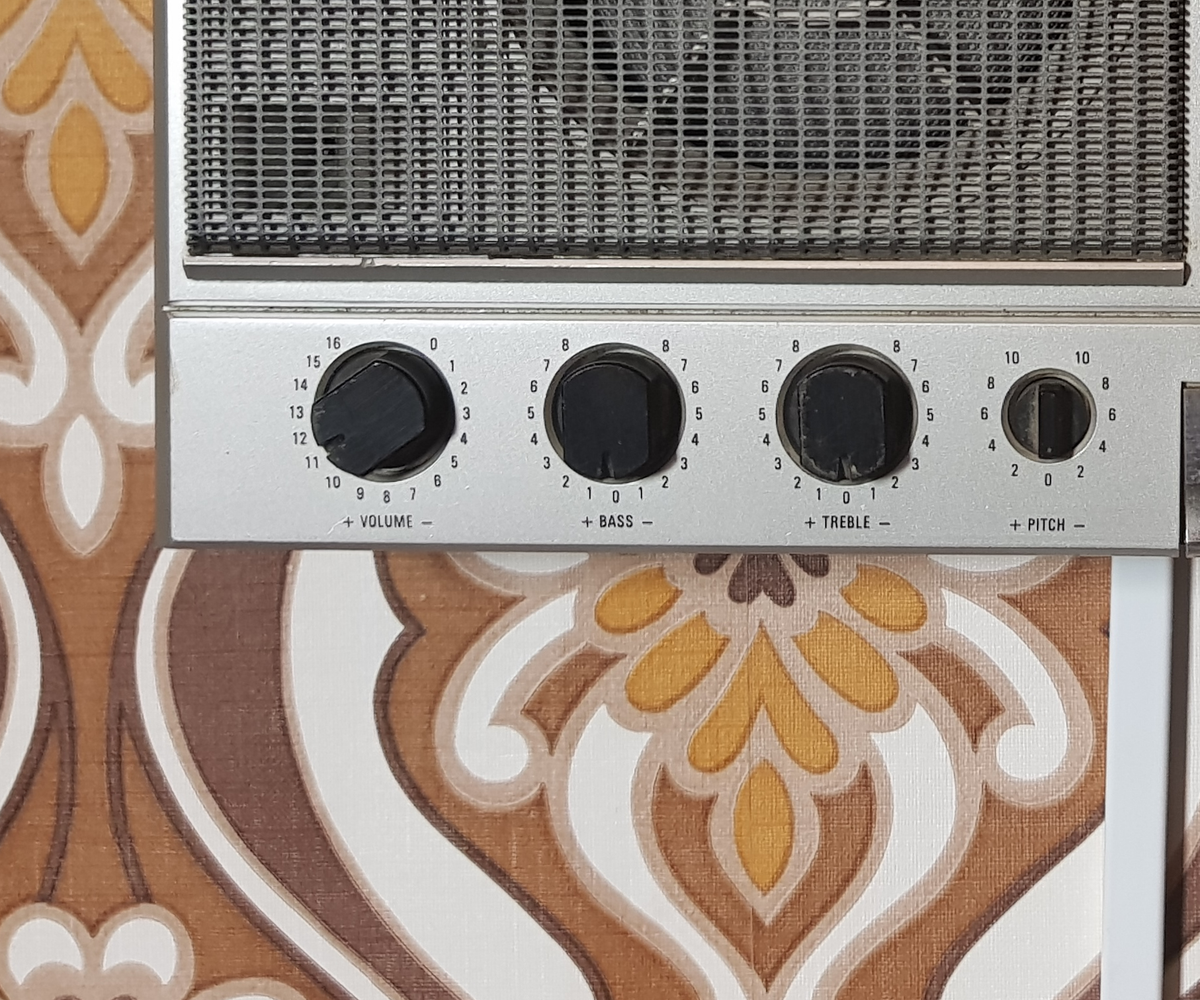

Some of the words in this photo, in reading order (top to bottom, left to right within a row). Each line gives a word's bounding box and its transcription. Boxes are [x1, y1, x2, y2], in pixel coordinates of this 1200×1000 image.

[326, 335, 341, 351] 16
[429, 337, 438, 352] 0
[561, 337, 570, 352] 8
[661, 338, 670, 353] 8
[791, 339, 800, 354] 8
[892, 339, 901, 354] 8
[306, 354, 321, 369] 15
[542, 358, 551, 372] 7
[680, 358, 688, 372] 7
[1004, 350, 1020, 365] 10
[1075, 350, 1090, 365] 10
[449, 359, 456, 373] 1
[775, 358, 783, 373] 7
[910, 358, 918, 373] 7
[293, 377, 309, 392] 14
[460, 380, 469, 396] 2
[529, 379, 538, 394] 6
[691, 380, 700, 395] 6
[761, 379, 770, 394] 6
[921, 379, 930, 394] 6
[986, 375, 995, 390] 8
[1101, 376, 1110, 391] 8
[289, 405, 304, 420] 13
[462, 406, 471, 421] 3
[527, 405, 535, 420] 5
[695, 406, 703, 421] 5
[758, 407, 767, 422] 5
[926, 407, 935, 422] 5
[980, 406, 989, 421] 6
[1108, 407, 1117, 422] 6
[292, 431, 308, 446] 12
[459, 431, 468, 446] 4
[530, 432, 539, 446] 4
[690, 432, 700, 447] 4
[762, 432, 771, 447] 4
[921, 434, 930, 448] 4
[987, 438, 997, 452] 4
[1098, 439, 1107, 453] 4
[305, 455, 320, 470] 11
[450, 454, 459, 469] 5
[543, 455, 551, 470] 3
[680, 456, 688, 471] 3
[774, 456, 782, 471] 3
[911, 457, 920, 471] 3
[1010, 463, 1019, 477] 2
[1076, 464, 1085, 479] 2
[325, 475, 341, 490] 10
[433, 473, 442, 488] 6
[562, 474, 570, 489] 2
[661, 474, 669, 489] 2
[793, 475, 802, 490] 2
[891, 475, 899, 490] 2
[1044, 472, 1053, 487] 0
[356, 486, 365, 501] 9
[382, 489, 391, 504] 8
[408, 487, 417, 501] 7
[586, 486, 592, 500] 1
[612, 489, 620, 504] 0
[638, 486, 644, 500] 1
[815, 487, 821, 501] 1
[842, 490, 851, 505] 0
[870, 486, 876, 501] 1
[359, 514, 413, 529] VOLUME
[599, 514, 634, 529] BASS
[821, 514, 871, 530] TREBLE
[1027, 517, 1066, 532] PITCH
